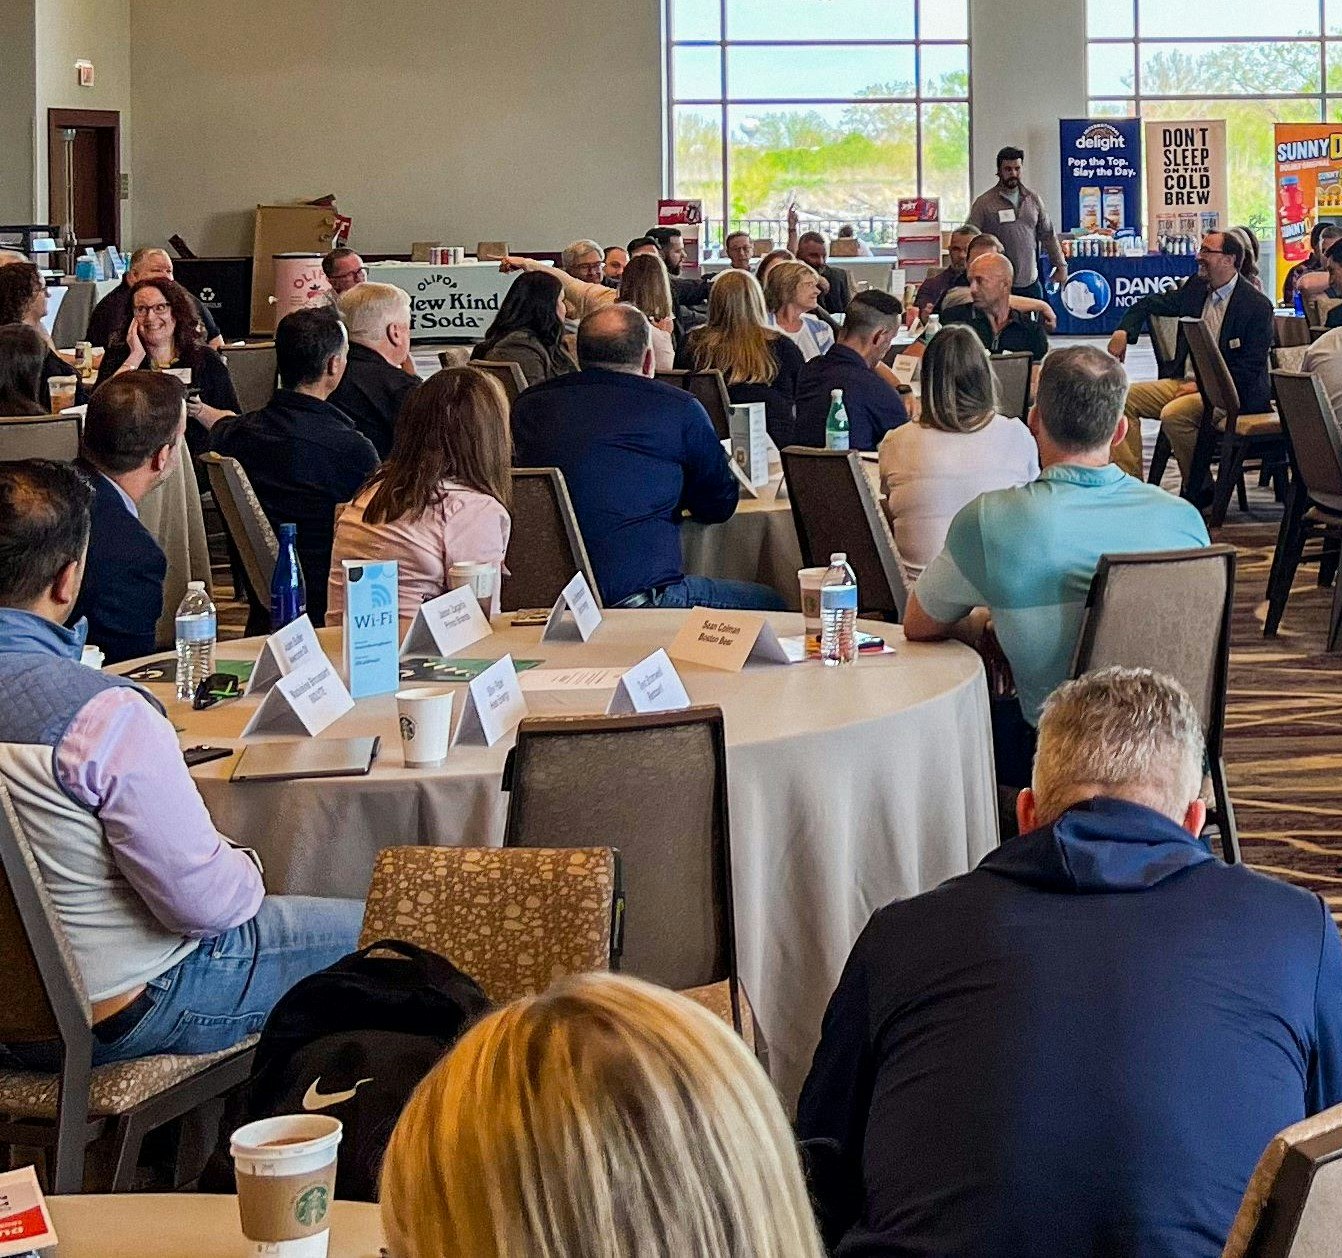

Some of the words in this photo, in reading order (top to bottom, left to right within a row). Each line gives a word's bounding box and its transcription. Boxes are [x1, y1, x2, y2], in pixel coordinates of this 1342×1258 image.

[1076, 134, 1126, 151] delight
[1163, 128, 1208, 147] DON'T
[1068, 157, 1087, 167] Pop
[1089, 157, 1105, 166] the
[1106, 157, 1128, 167] Top.
[1164, 148, 1209, 166] SLEEP
[1073, 168, 1094, 178] Slay
[1096, 167, 1112, 176] the
[1115, 167, 1136, 177] Day.
[1164, 174, 1210, 190] COLD
[1164, 190, 1210, 205] BREW
[417, 274, 458, 292] OLIPOP
[450, 293, 499, 310] Kind
[354, 611, 393, 629] Wi-Fi
[698, 632, 719, 643] Boston
